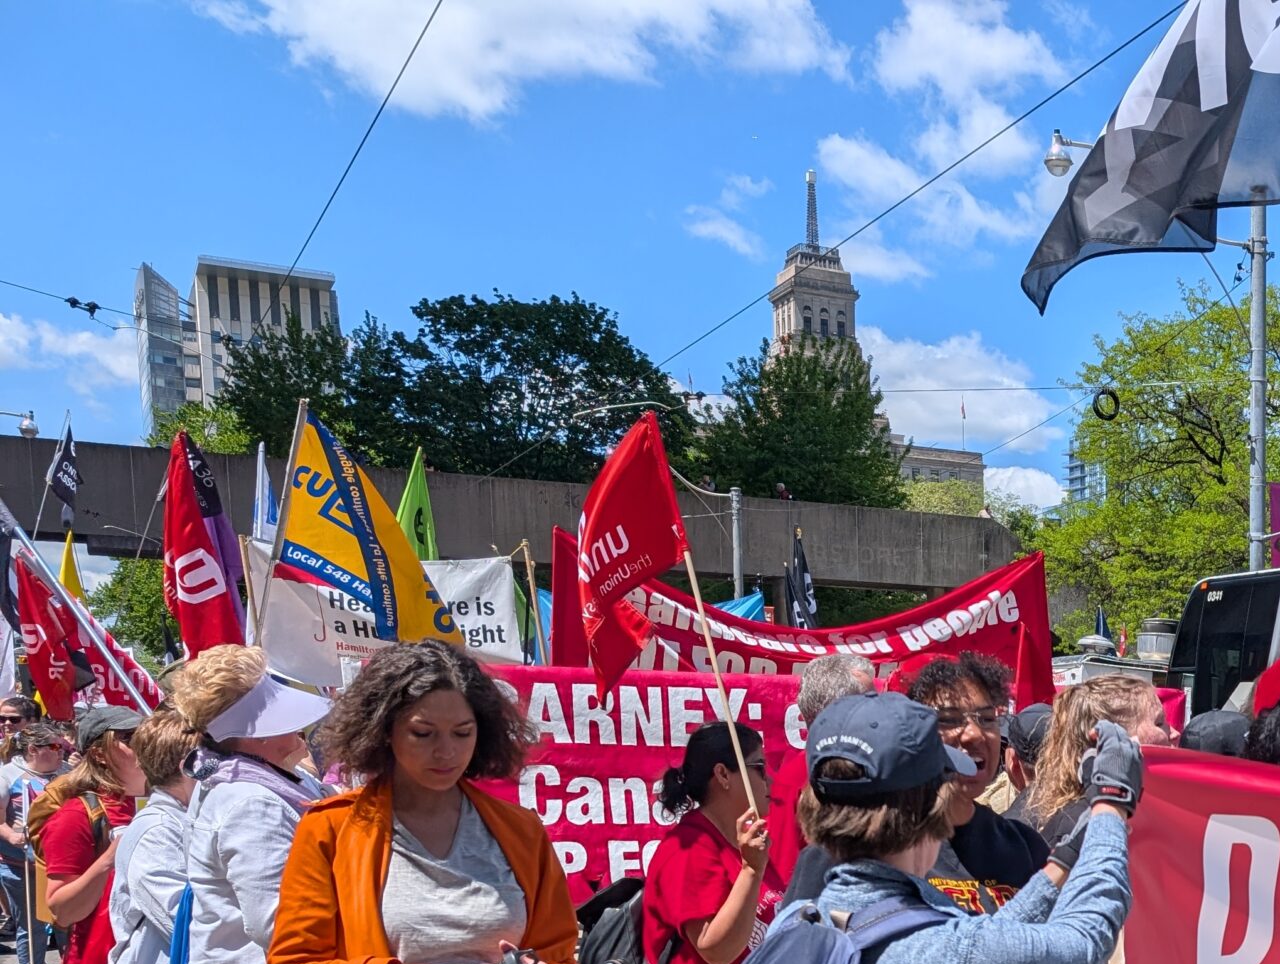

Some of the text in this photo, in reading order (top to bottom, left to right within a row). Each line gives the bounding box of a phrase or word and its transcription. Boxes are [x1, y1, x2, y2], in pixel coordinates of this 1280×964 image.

[287, 546, 323, 569] Local
[323, 564, 352, 583] 548
[476, 595, 496, 616] is
[1207, 590, 1223, 602] 0341
[334, 620, 347, 634] a
[461, 622, 507, 648] ight
[898, 587, 1020, 653] people
[495, 679, 764, 748] ARNEY:
